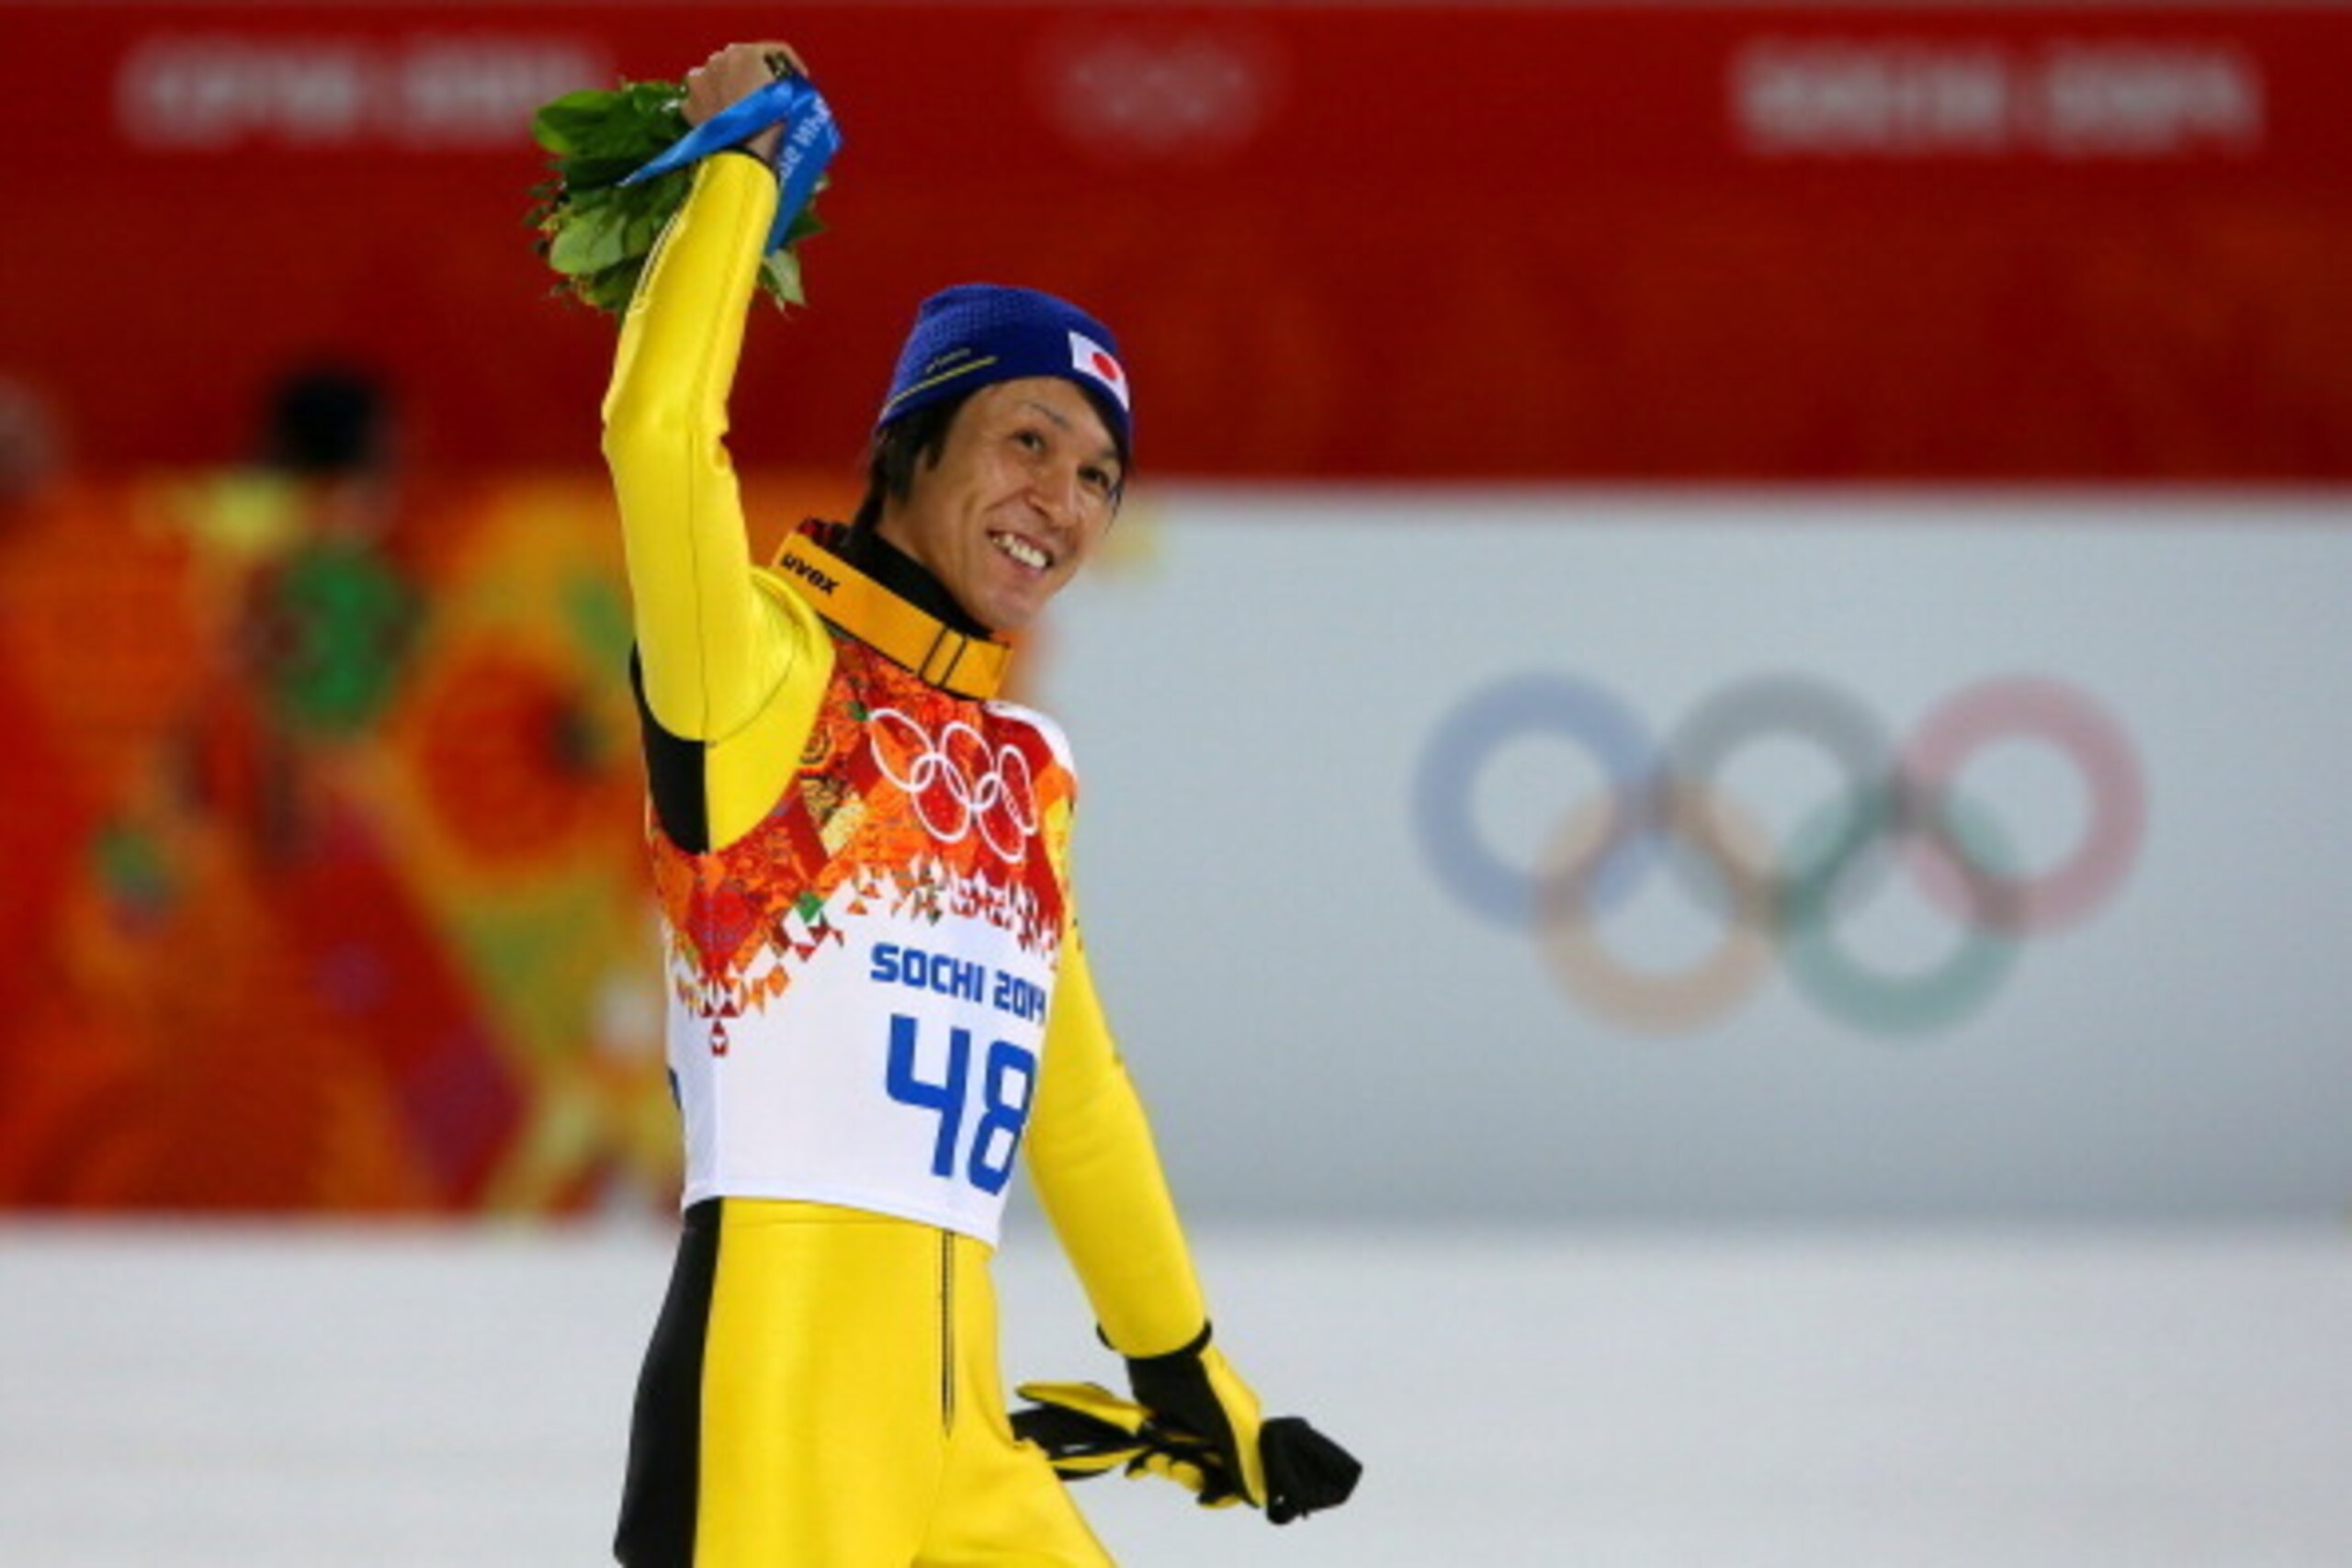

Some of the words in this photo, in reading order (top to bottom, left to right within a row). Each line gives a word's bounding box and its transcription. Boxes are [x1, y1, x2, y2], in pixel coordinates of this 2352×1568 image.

[781, 553, 840, 595] uvex
[871, 942, 983, 1003] SOCHI
[993, 969, 1046, 1025] 2014
[887, 1012, 1036, 1197] 48
